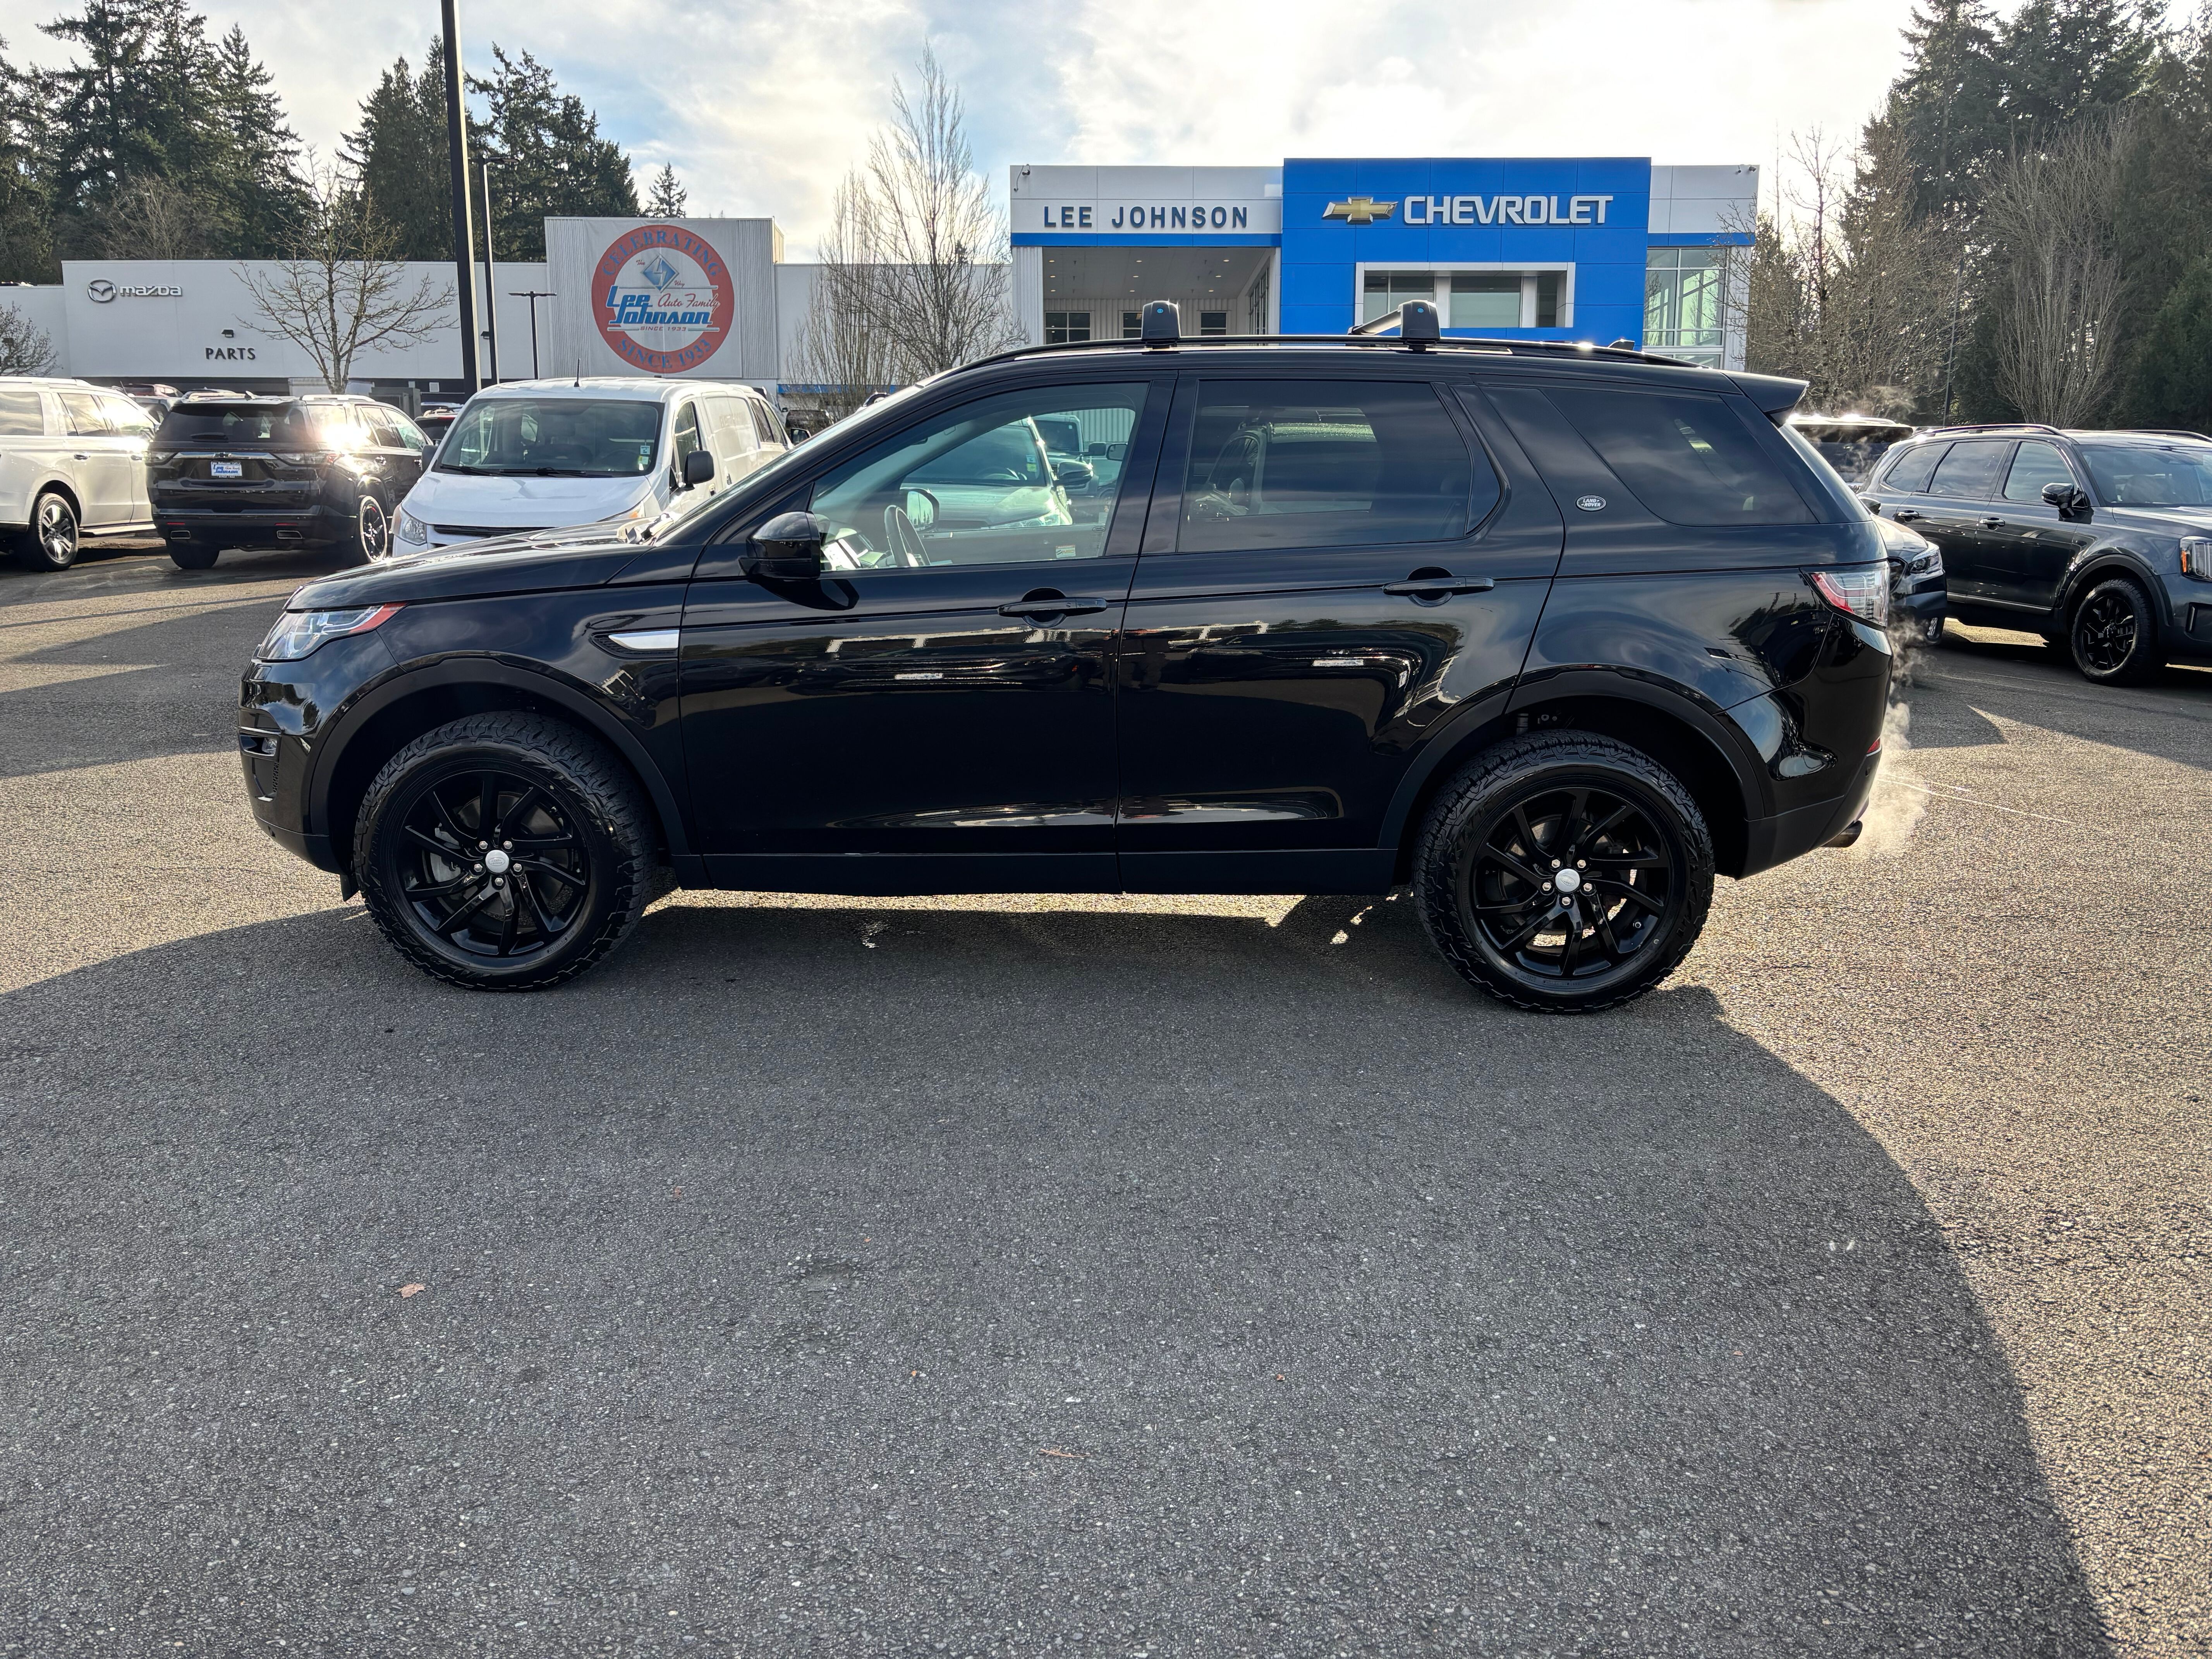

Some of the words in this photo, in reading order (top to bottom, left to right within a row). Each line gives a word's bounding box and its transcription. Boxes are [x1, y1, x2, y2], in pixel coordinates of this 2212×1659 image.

[1044, 206, 1093, 228] LEE
[1111, 206, 1247, 228] JOHNSON
[1404, 195, 1614, 225] CHEVROLET
[602, 230, 721, 276] CELEBRATING
[606, 285, 653, 307] Lee
[658, 293, 684, 307] Auto
[685, 293, 721, 313] Family
[609, 303, 713, 325] Johnson
[205, 347, 256, 360] PARTS
[618, 339, 673, 369] SINCE
[678, 338, 712, 366] 1933
